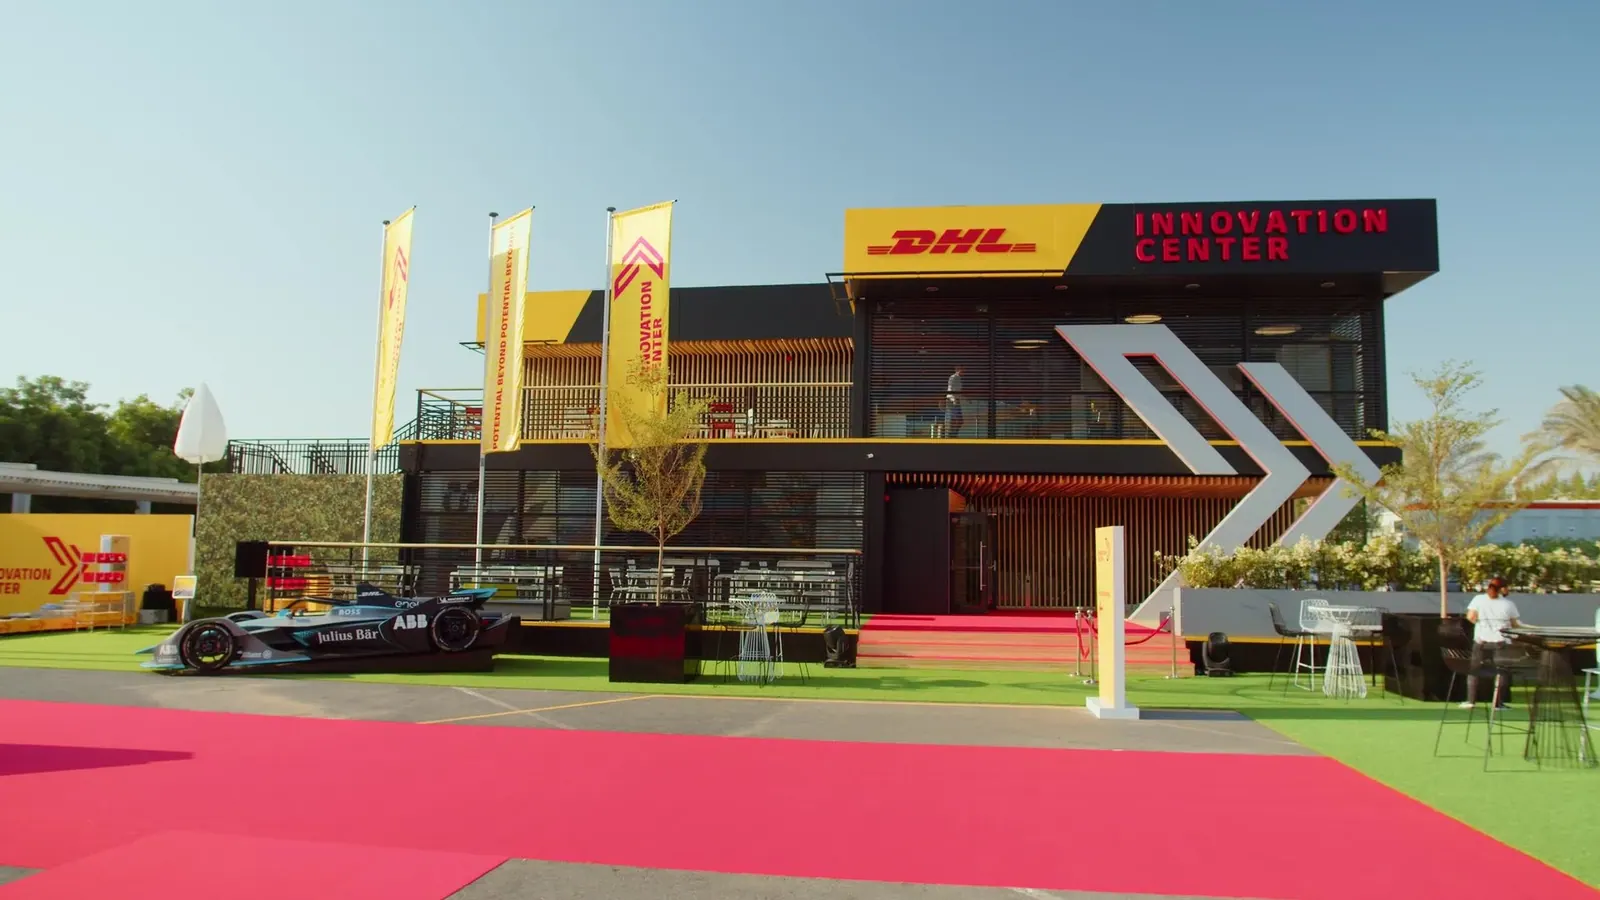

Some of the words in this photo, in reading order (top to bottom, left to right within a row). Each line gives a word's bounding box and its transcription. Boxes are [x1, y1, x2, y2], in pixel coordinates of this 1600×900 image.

[1135, 208, 1388, 236] INNOVATION
[868, 228, 1036, 255] DHL
[1136, 236, 1289, 262] CENTER
[500, 278, 512, 338] POTENTIAL
[497, 340, 507, 386] BEYOND
[493, 388, 503, 450] POTENTIAL
[338, 608, 361, 616] BOSS
[393, 614, 428, 630] ABB
[317, 630, 353, 644] Julius
[355, 628, 379, 640] Bär
